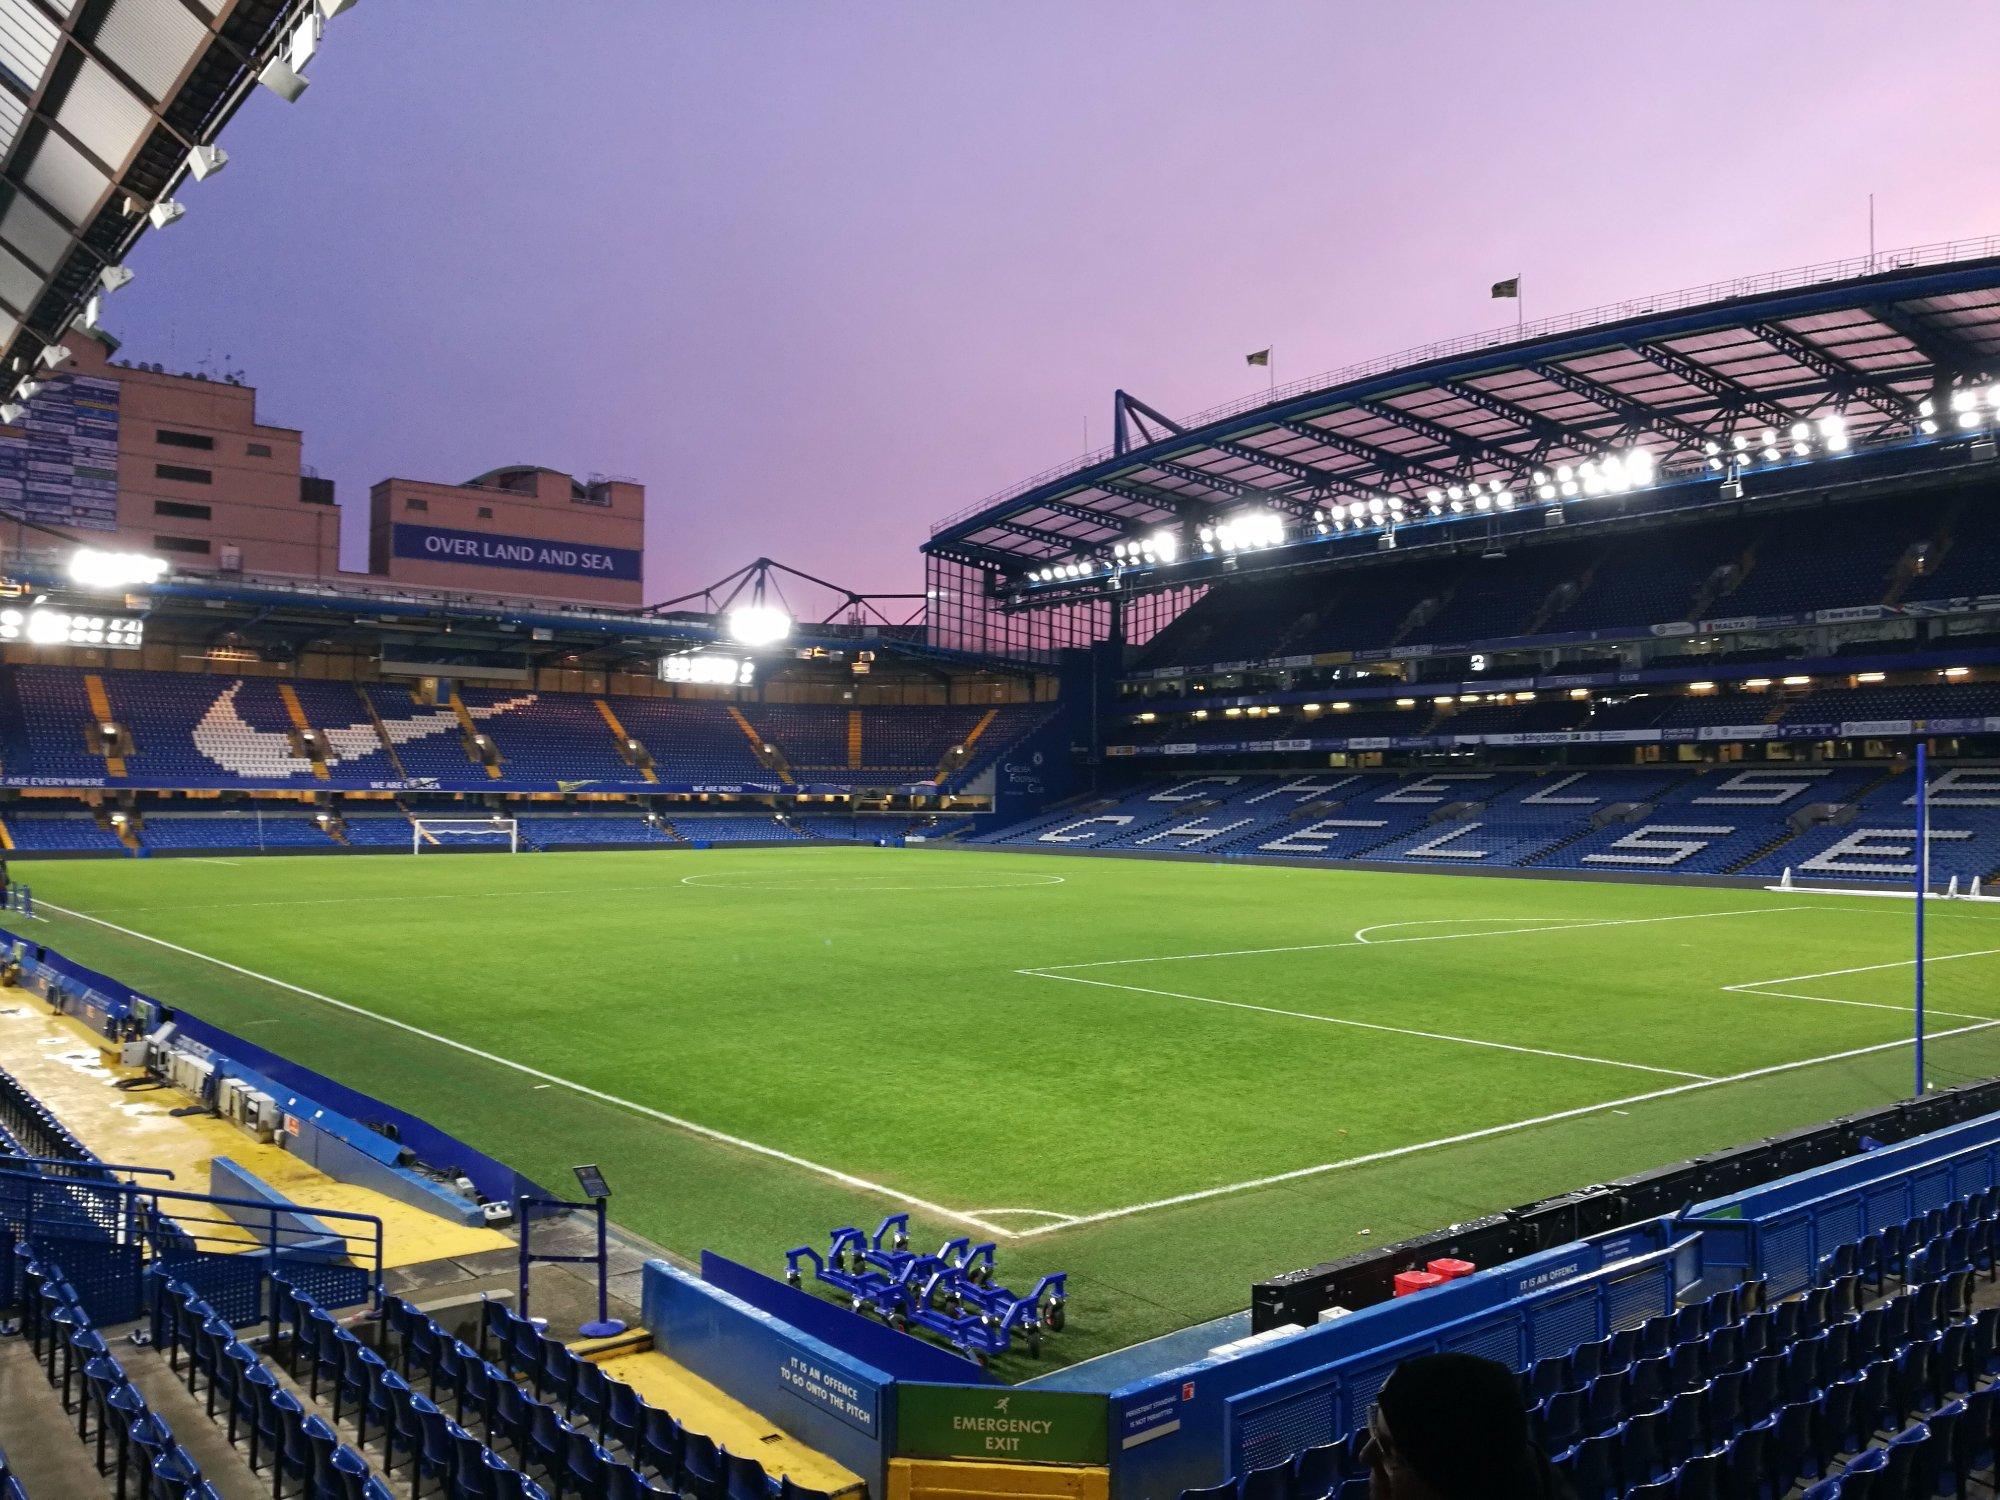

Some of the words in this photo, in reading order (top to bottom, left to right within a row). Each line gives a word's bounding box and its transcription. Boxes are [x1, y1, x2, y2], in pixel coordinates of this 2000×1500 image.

[425, 536, 479, 557] OVER
[483, 542, 535, 562] LAND
[538, 548, 578, 567] AND
[581, 552, 614, 571] SEA
[1556, 676, 1594, 685] FOOTBALL
[1619, 673, 1640, 682] CLUB
[5, 777, 29, 786] ARE
[30, 777, 105, 786] EVERYWHERE
[369, 781, 386, 789] WE
[386, 781, 403, 789] ARE
[719, 785, 742, 793] PROUD
[1520, 1280, 1527, 1291] IT
[1528, 1277, 1536, 1288] IS
[1536, 1274, 1548, 1284] AN
[1550, 1263, 1578, 1280] OFFENCE
[790, 1356, 798, 1368] IT
[800, 1361, 807, 1374] IS
[809, 1367, 821, 1381] AN
[823, 1374, 858, 1401] OFFENCE
[780, 1366, 791, 1380] TO
[792, 1373, 804, 1387] GO
[805, 1380, 828, 1400] ONTO
[829, 1392, 844, 1410] THE
[846, 1402, 871, 1424] PITCH
[952, 1416, 1053, 1434] EMERGENCY
[1136, 1416, 1147, 1426] NOT
[1147, 1408, 1174, 1423] PERMITTED
[985, 1436, 1020, 1451] EXIT
